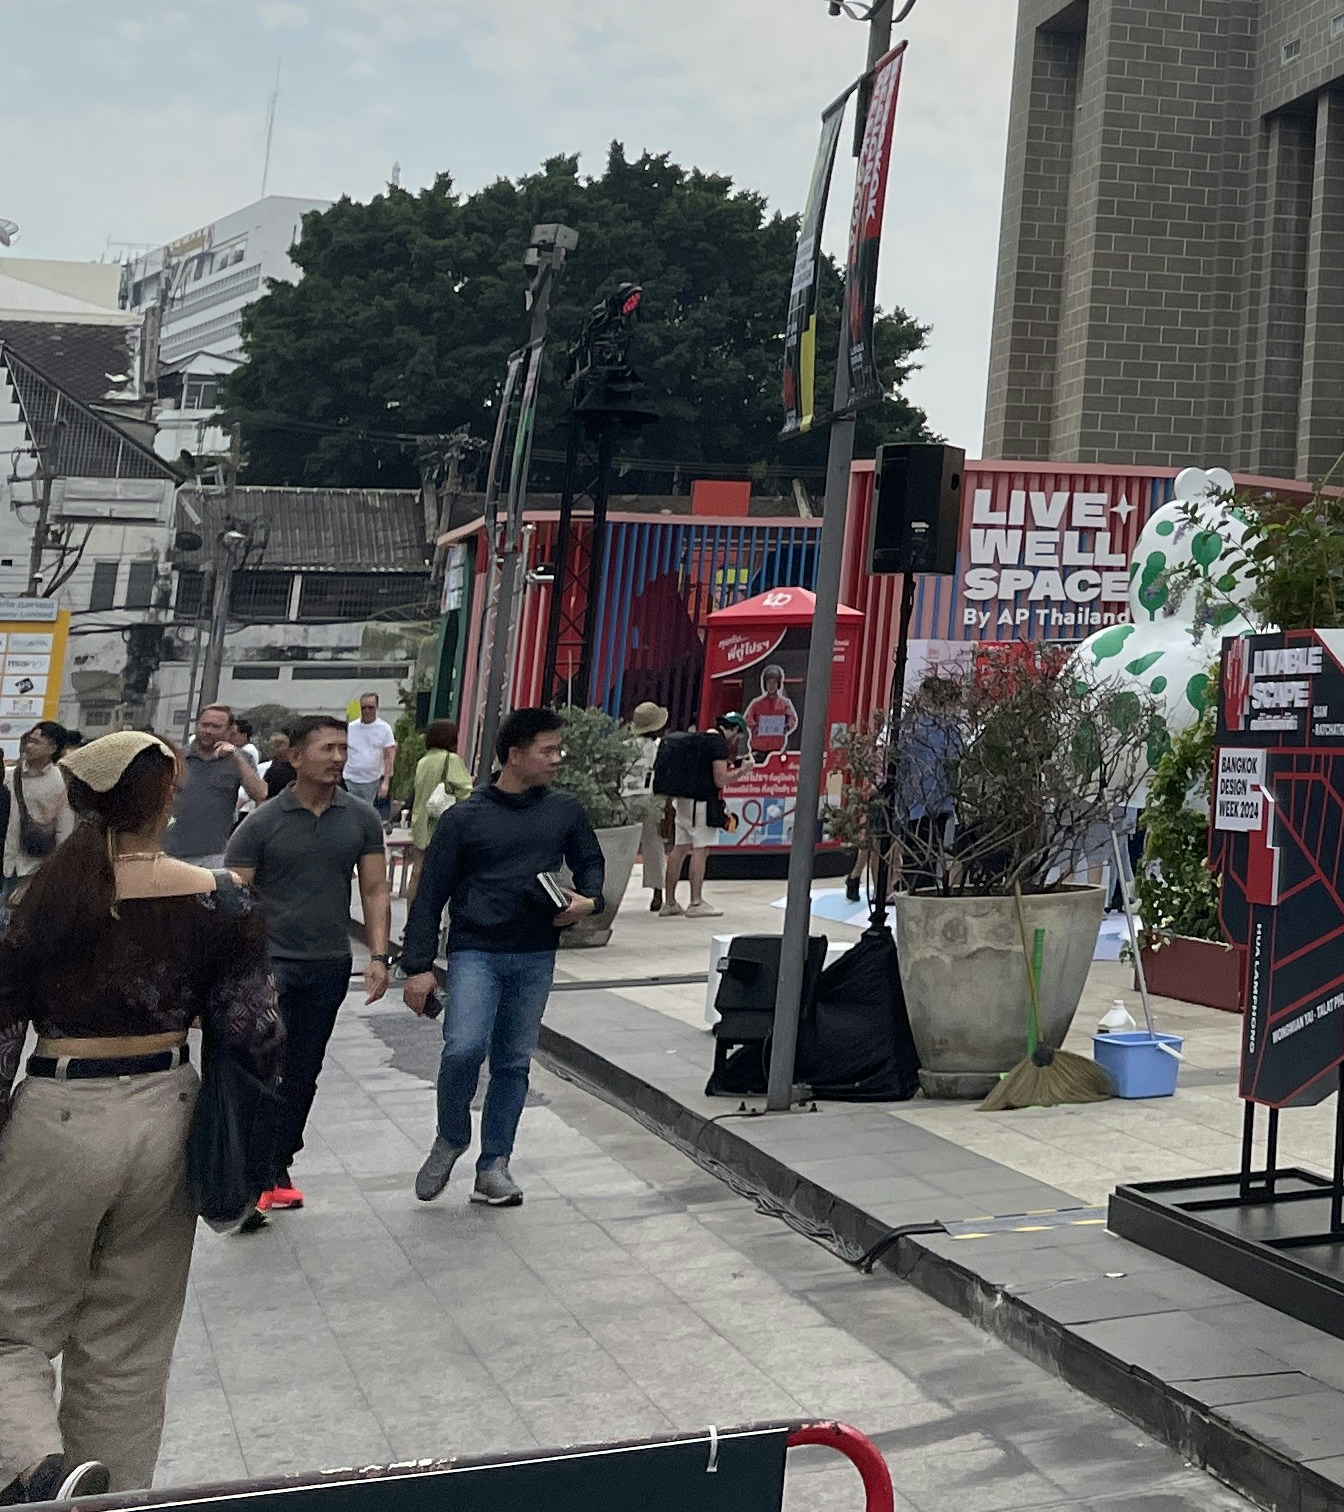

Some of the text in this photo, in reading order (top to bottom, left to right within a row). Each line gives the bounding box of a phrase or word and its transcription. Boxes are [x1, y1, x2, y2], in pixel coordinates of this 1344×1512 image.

[972, 489, 1108, 529] LIVE
[970, 529, 1127, 567] WELL
[963, 567, 1131, 603] SPACE
[963, 607, 1131, 629] By AP Thailand
[1251, 680, 1310, 710] SCAPE
[1221, 756, 1258, 774] BANGKOK
[1220, 778, 1248, 797] DESIGN
[1219, 801, 1260, 819] WEEK 2024
[1249, 923, 1263, 1054] HUA LAMPHONG
